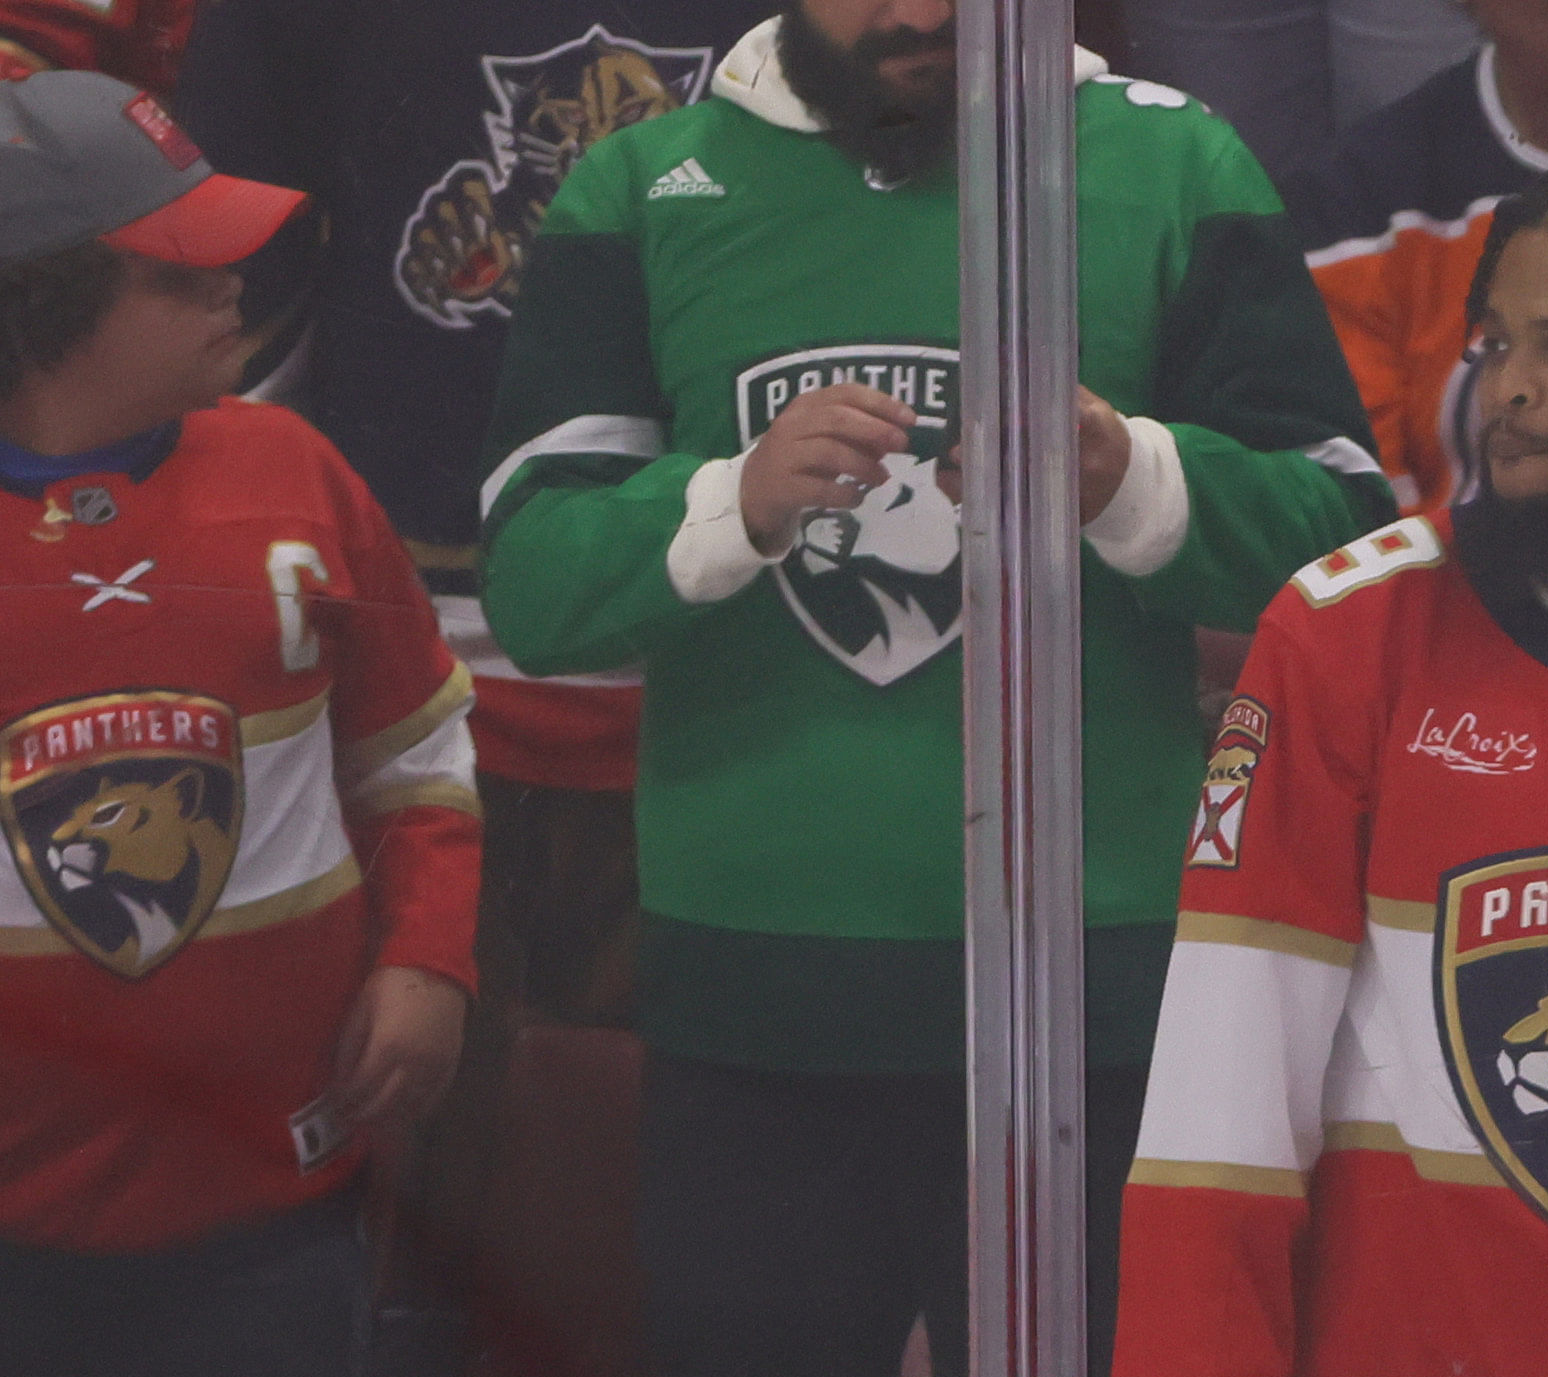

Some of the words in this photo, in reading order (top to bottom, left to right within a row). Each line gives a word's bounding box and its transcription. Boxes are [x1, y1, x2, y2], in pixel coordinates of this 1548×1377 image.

[648, 181, 727, 199] adidas
[267, 541, 330, 671] C
[22, 710, 221, 772] PANTHERS
